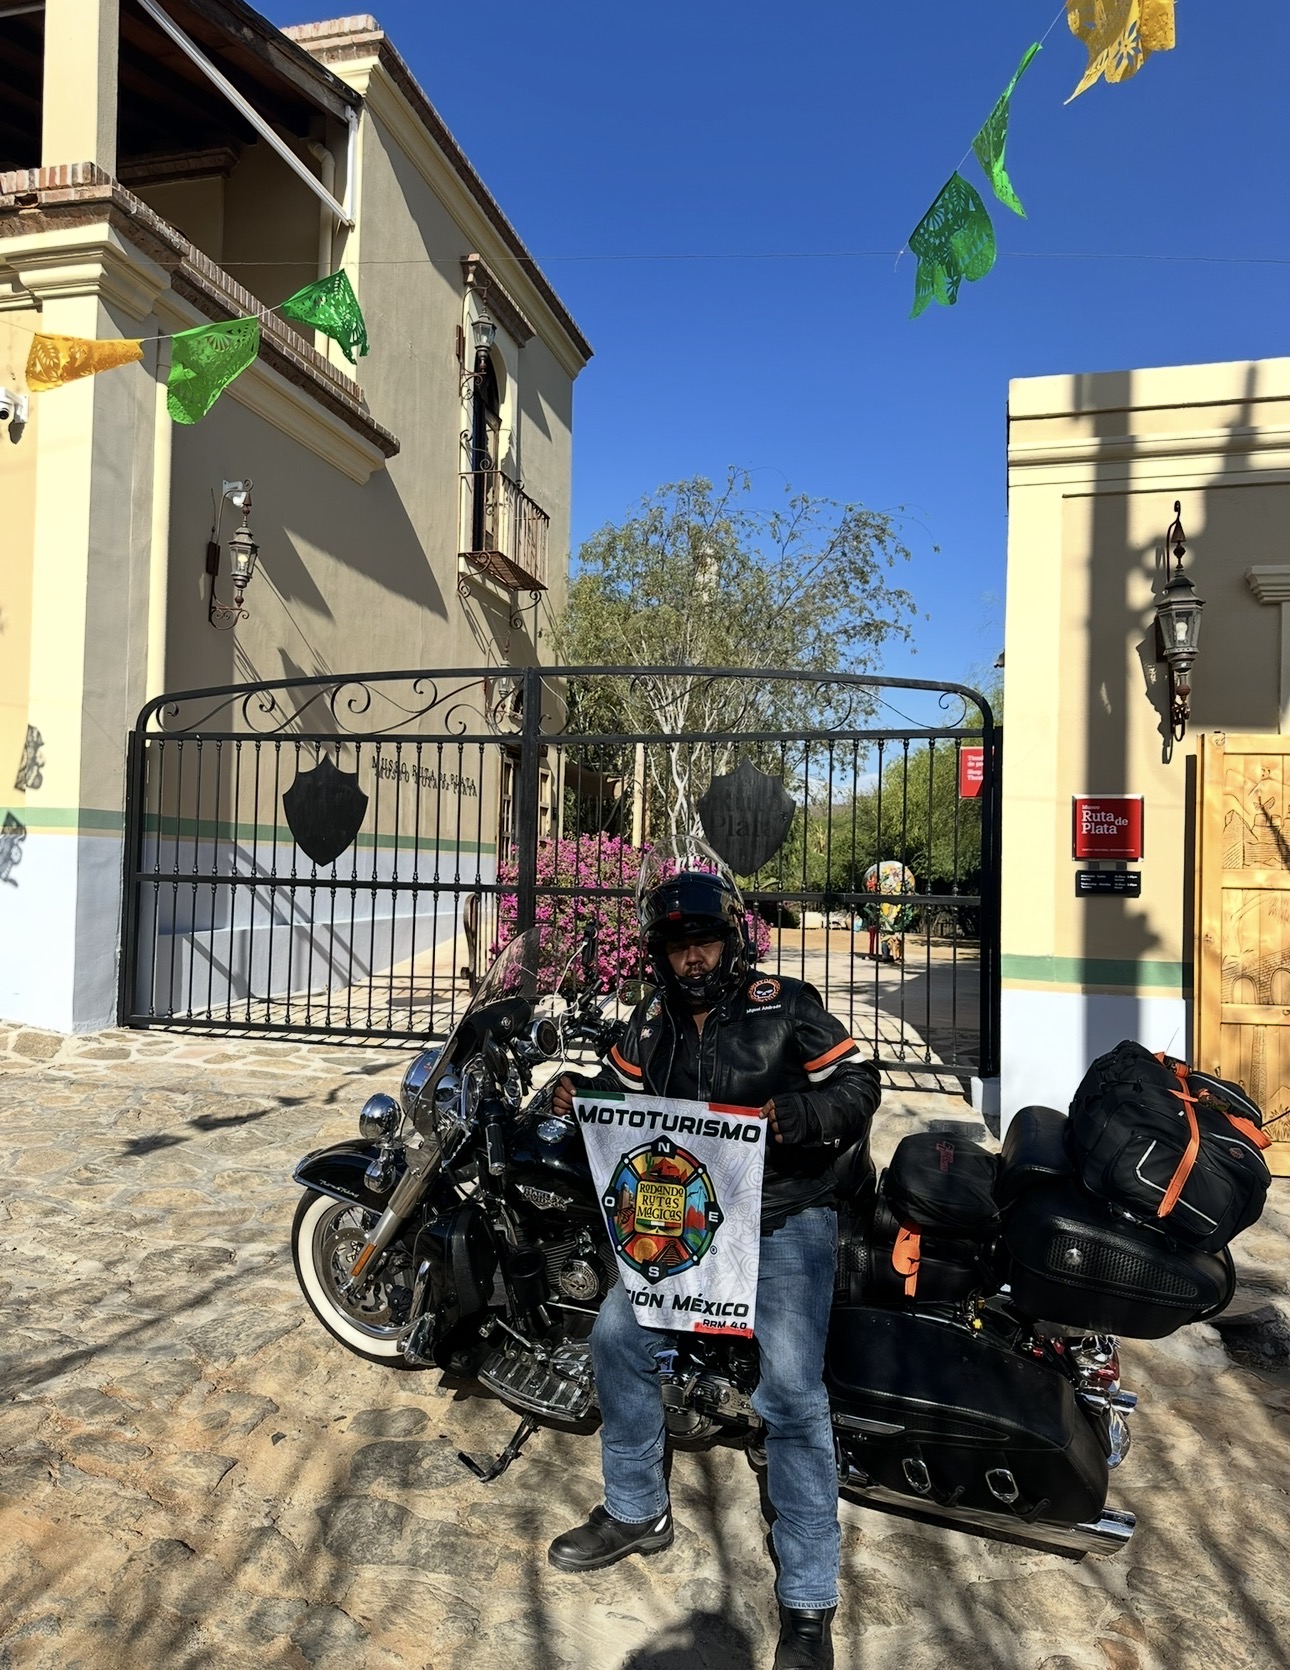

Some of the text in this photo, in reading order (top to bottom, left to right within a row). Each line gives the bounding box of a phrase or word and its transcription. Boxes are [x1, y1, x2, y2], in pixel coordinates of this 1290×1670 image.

[1081, 810, 1129, 826] Ruta de
[1081, 822, 1118, 834] Plata
[658, 1142, 671, 1153] N
[604, 1197, 616, 1207] O
[708, 1211, 719, 1222] E
[648, 1266, 660, 1277] S
[672, 1293, 750, 1318] MÉXICO
[702, 1318, 726, 1329] RRM
